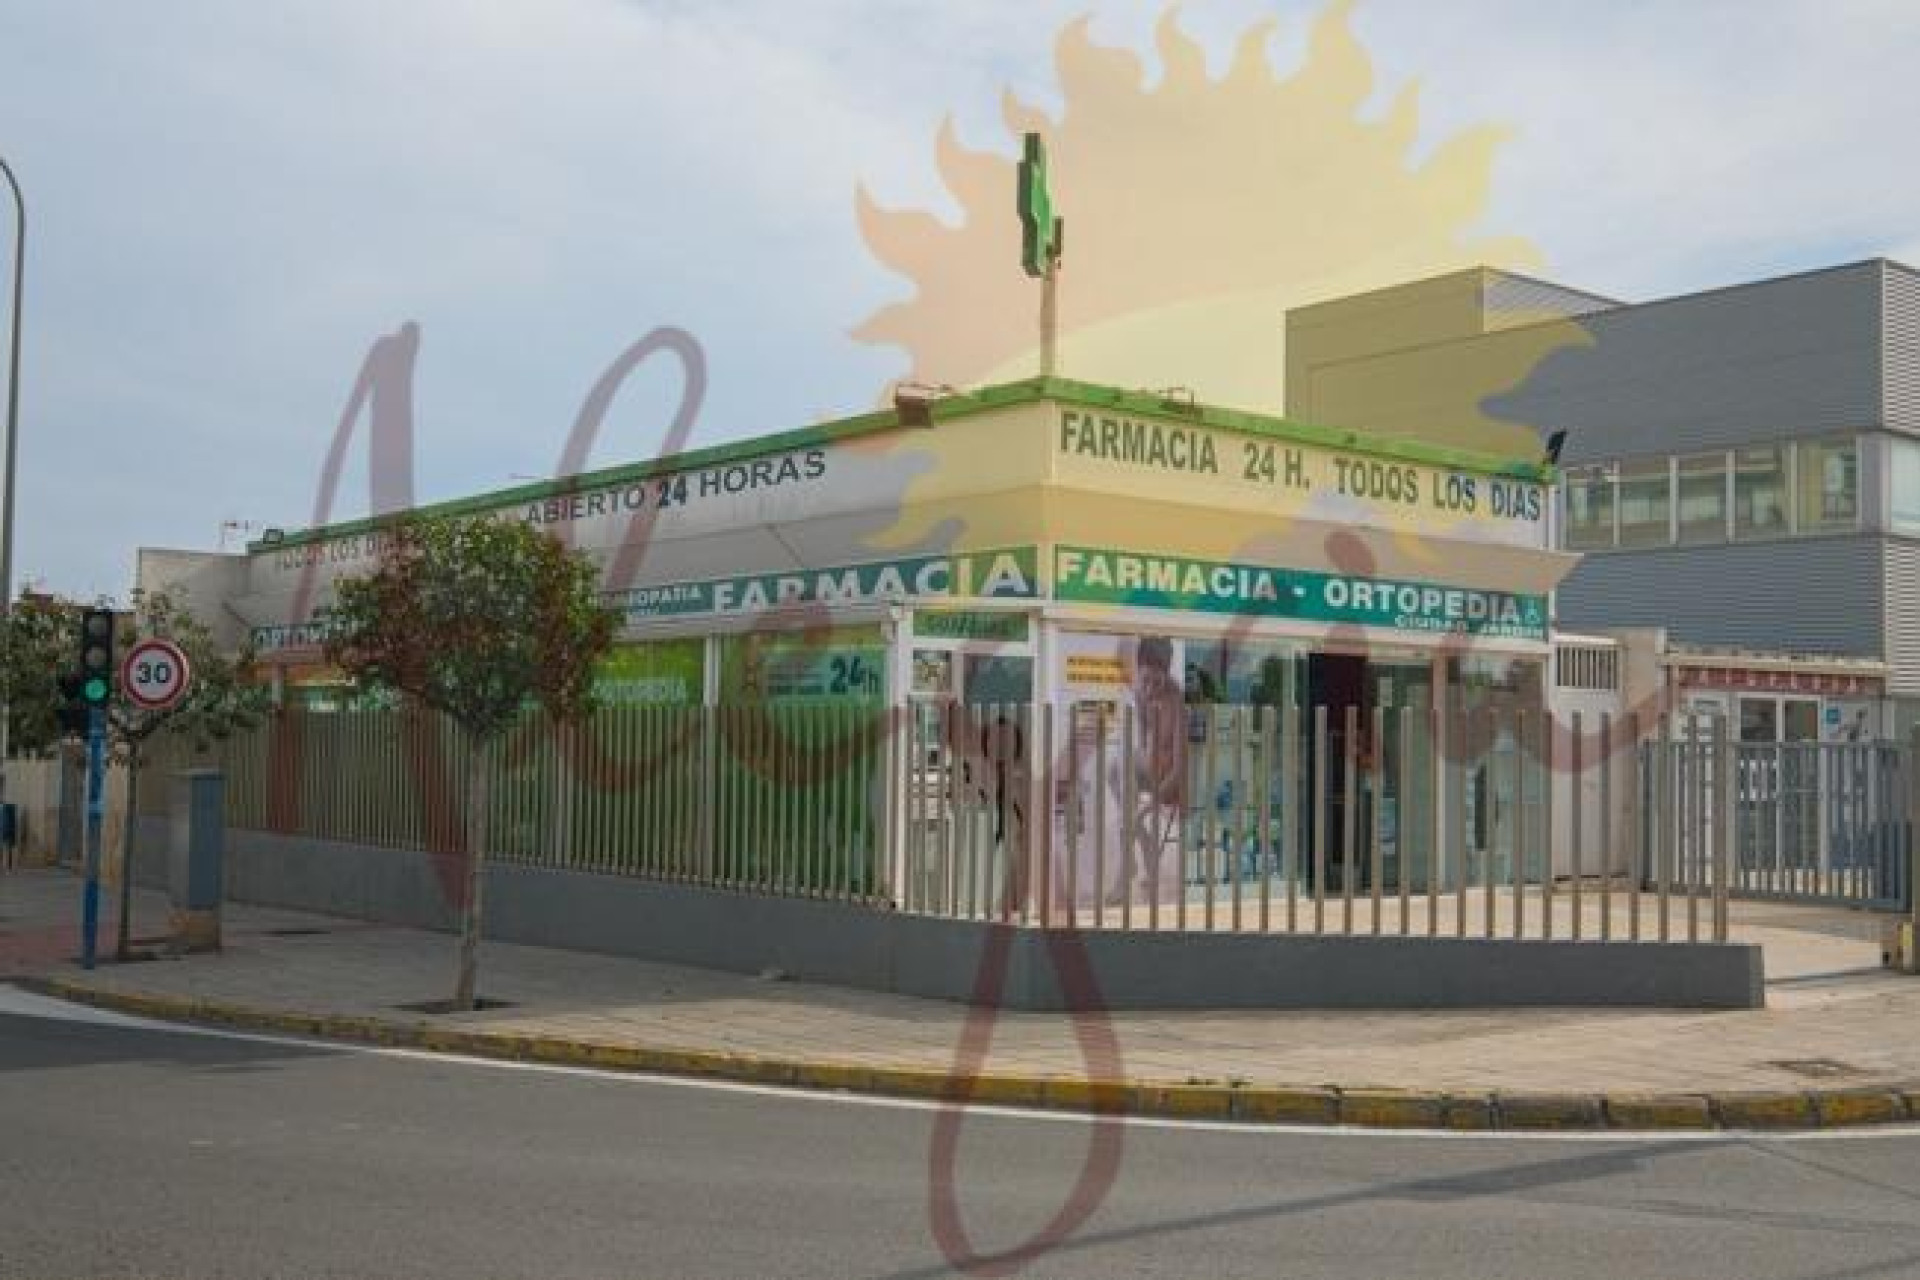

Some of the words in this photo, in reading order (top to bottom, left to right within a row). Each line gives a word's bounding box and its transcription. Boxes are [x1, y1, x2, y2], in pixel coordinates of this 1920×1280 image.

[526, 487, 645, 525] ABIERTO
[657, 475, 688, 509] 24
[699, 450, 827, 497] HORAS
[1060, 412, 1220, 476] FARMACIA
[1243, 442, 1276, 484] 24
[1285, 450, 1311, 489] H.
[1333, 457, 1419, 504] TODOS
[1432, 472, 1477, 514] LOS
[1491, 481, 1542, 522] DIAS
[713, 554, 1031, 614] FARMACIA
[1057, 551, 1278, 602] FARMACIA
[1323, 578, 1522, 625] ORTOPEDIA
[135, 661, 173, 685] 30
[829, 655, 880, 695] 24h
